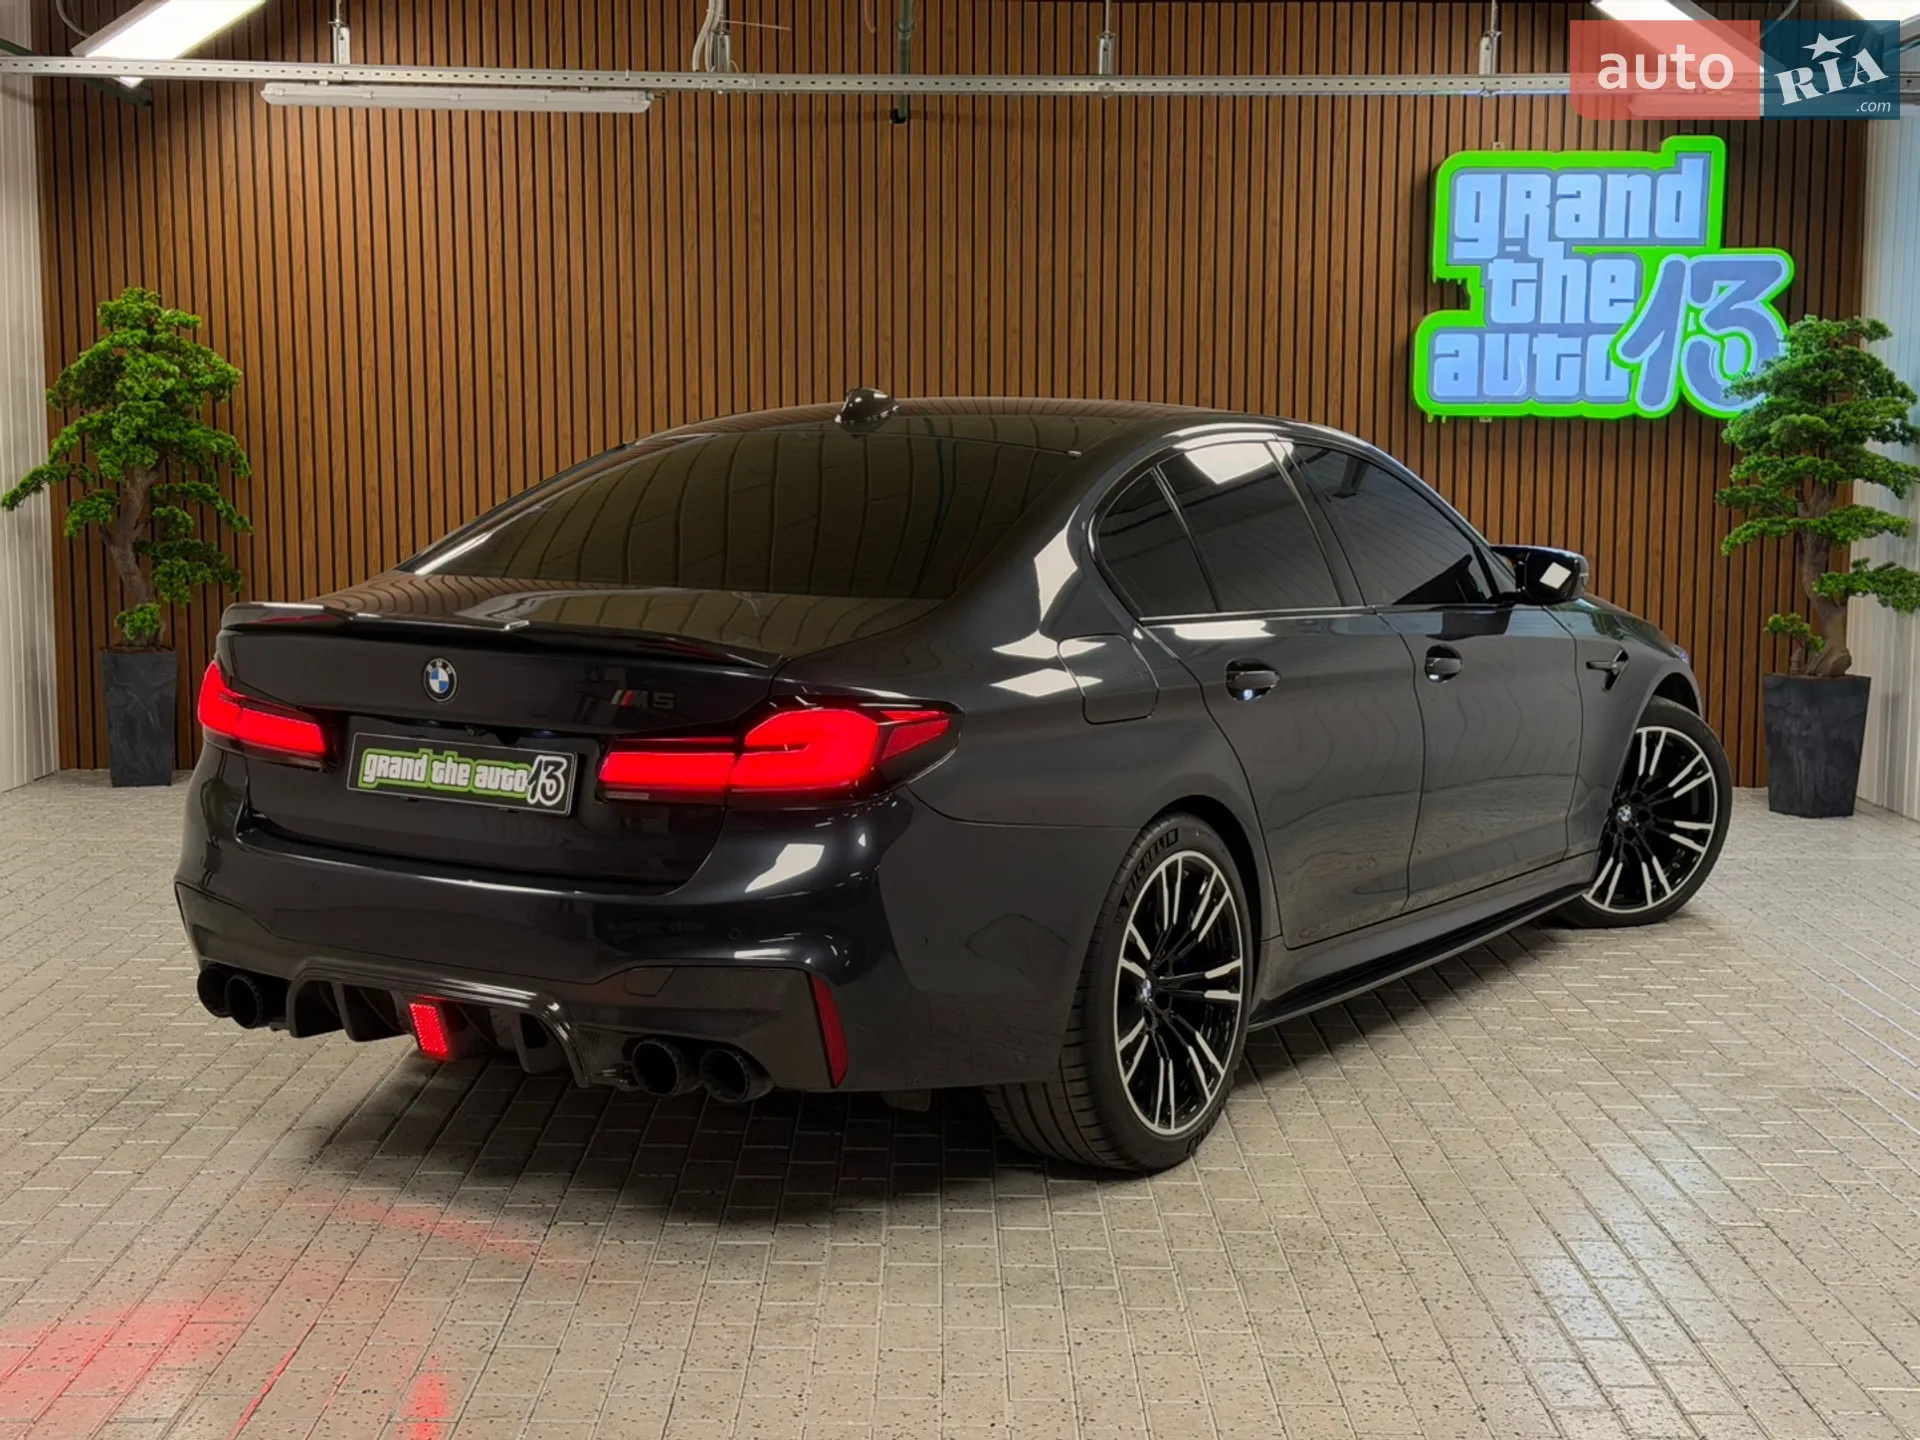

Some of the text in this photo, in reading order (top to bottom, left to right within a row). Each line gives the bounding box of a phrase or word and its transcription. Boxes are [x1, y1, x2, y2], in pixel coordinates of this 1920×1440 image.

[1488, 242, 1638, 325] the
[1616, 252, 1790, 412] 13
[432, 756, 471, 787] the
[474, 764, 529, 793] auto
[526, 754, 567, 806] 13
